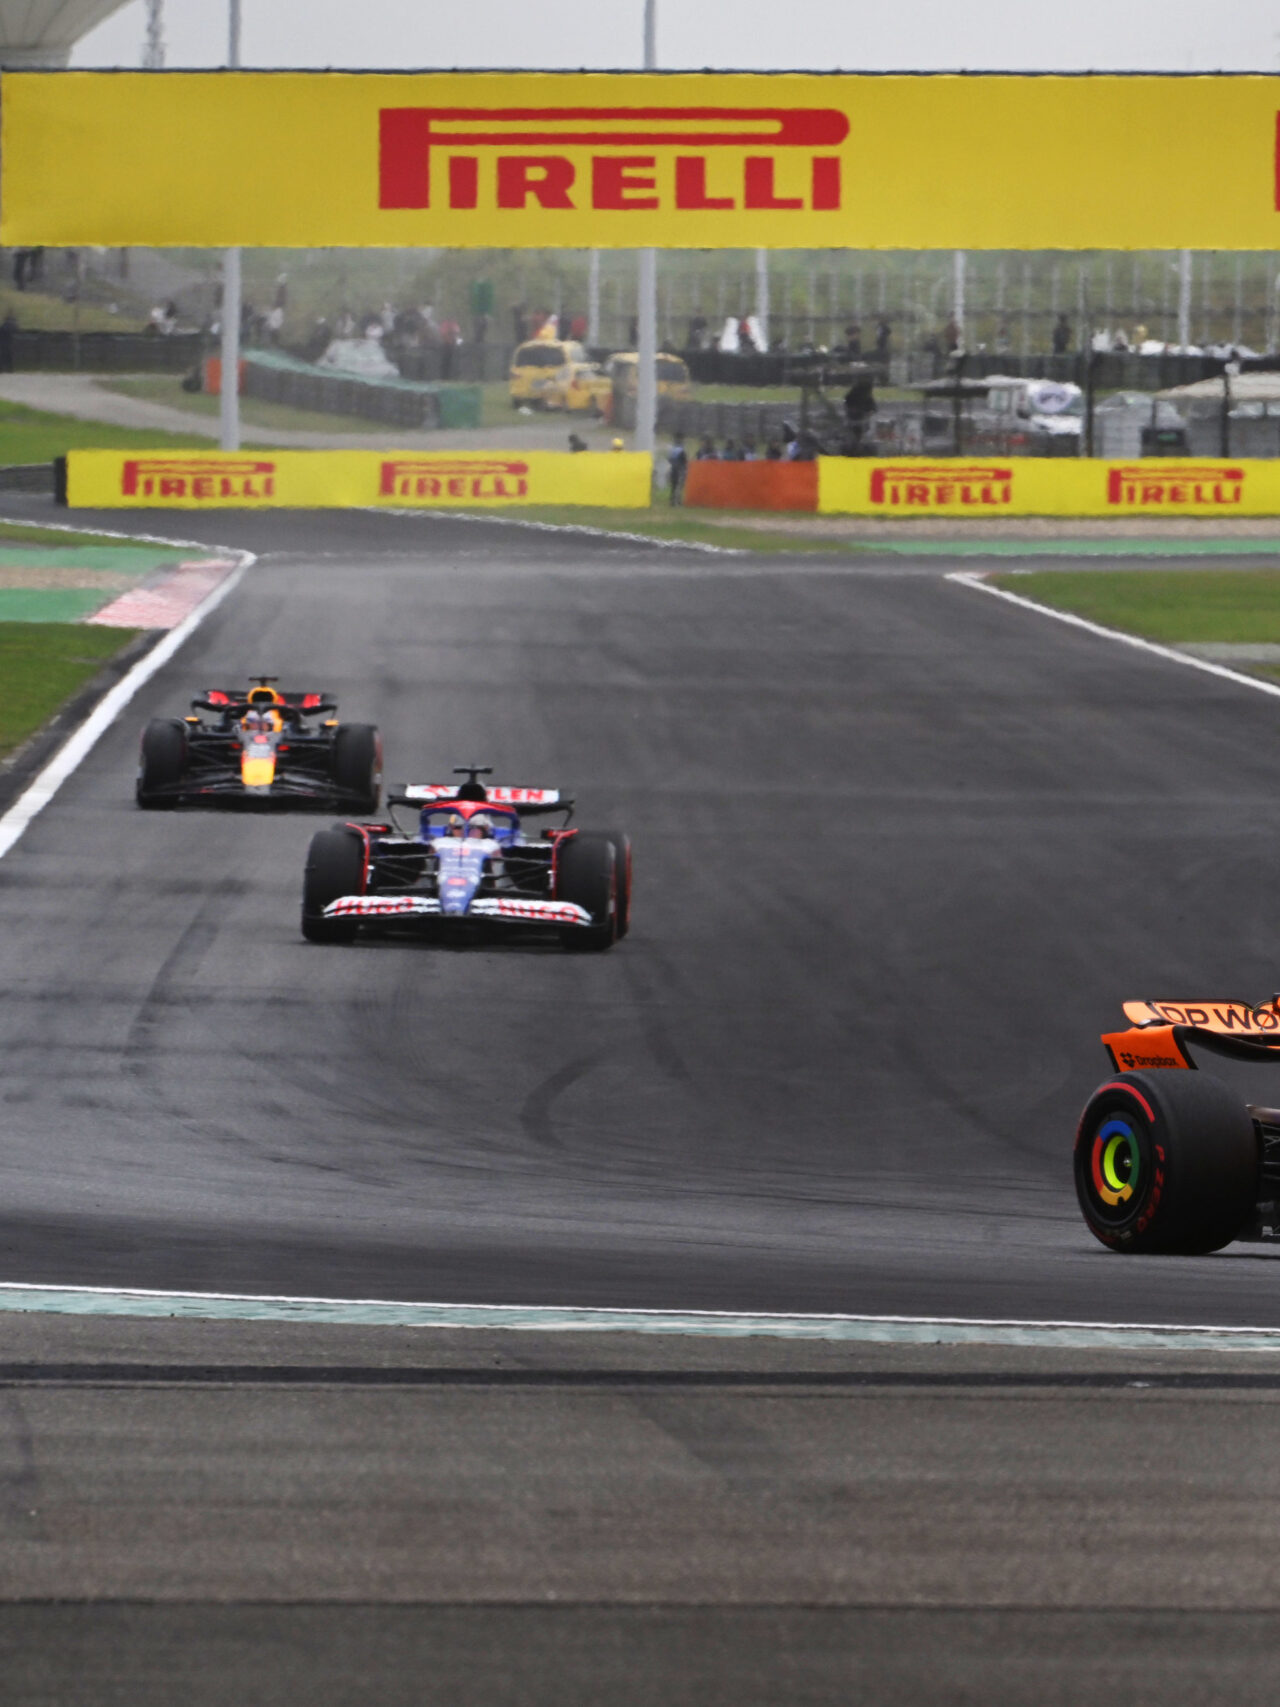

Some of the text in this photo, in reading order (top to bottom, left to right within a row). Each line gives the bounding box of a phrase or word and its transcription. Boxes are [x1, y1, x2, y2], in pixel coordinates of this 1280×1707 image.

[379, 107, 850, 210] PIRELLI
[122, 461, 275, 498] PIRELLI
[381, 462, 528, 497] PIRELLI
[870, 467, 1013, 505] PIRELLI
[1107, 467, 1245, 505] PIRELLI
[488, 789, 544, 801] LEN
[335, 898, 414, 915] HUGO
[498, 898, 579, 922] HUGO
[1161, 1006, 1210, 1026] DP
